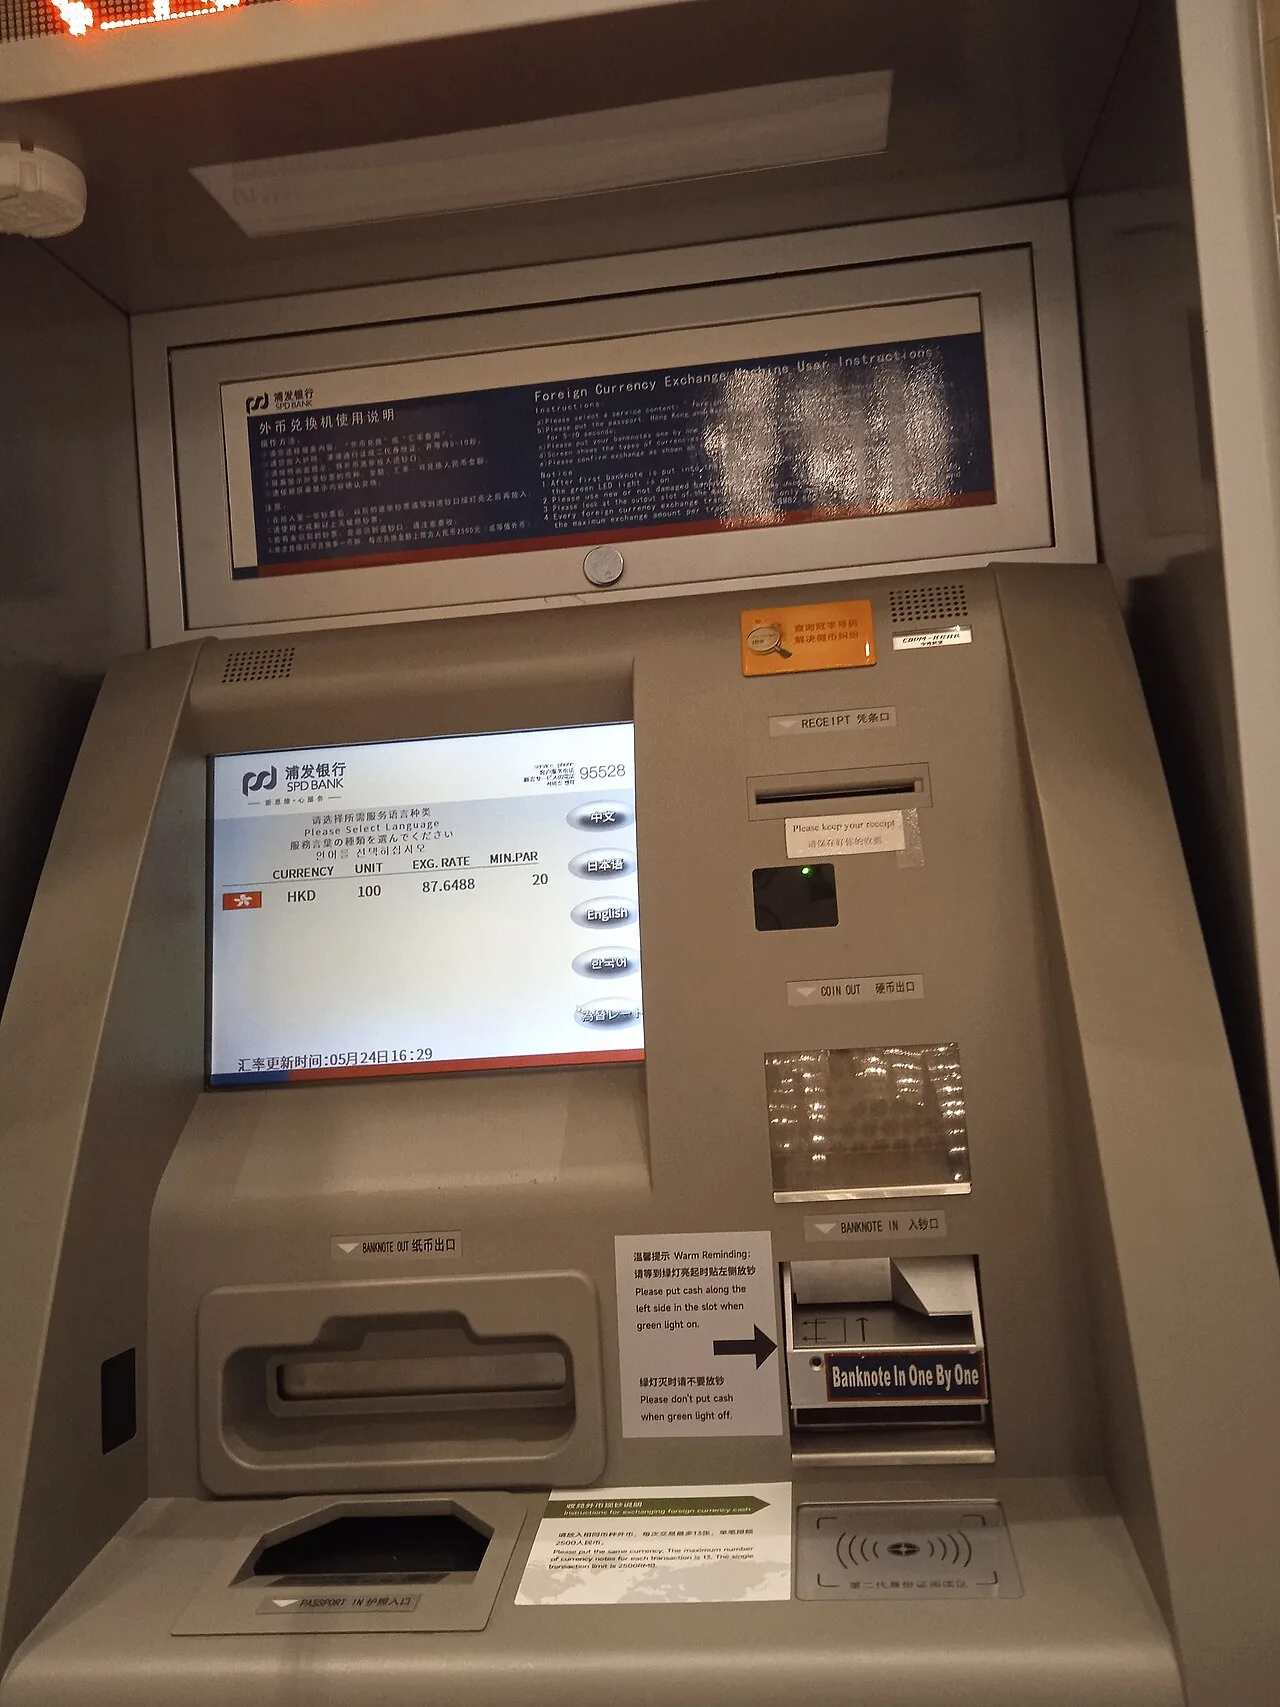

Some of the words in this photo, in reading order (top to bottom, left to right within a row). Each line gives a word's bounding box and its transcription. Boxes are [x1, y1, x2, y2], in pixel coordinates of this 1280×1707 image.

[535, 388, 588, 403] Foreign
[595, 380, 657, 395] Currency
[664, 371, 727, 387] Exchange
[797, 360, 828, 372] User
[839, 348, 933, 367] Instructions
[273, 388, 314, 402] 浦发银行
[275, 402, 292, 411] SPD
[291, 399, 313, 409] BANK
[259, 408, 395, 435] 外币兑换机使用说明
[550, 479, 573, 487] After
[579, 475, 601, 483] first
[605, 472, 643, 481] banknote
[661, 468, 675, 476] put
[570, 486, 594, 495] green
[598, 482, 613, 490] LED
[618, 480, 641, 489] light
[655, 483, 689, 493] damaged
[552, 504, 578, 512] Please
[582, 501, 598, 509] look
[631, 495, 656, 504] output
[553, 512, 577, 521] Every
[581, 508, 614, 517] foreign
[618, 504, 656, 514] currency
[660, 499, 699, 509] exchange
[554, 521, 568, 529] the
[572, 518, 606, 527] maximum
[610, 513, 648, 523] exchange
[653, 509, 682, 518] amount
[686, 508, 700, 516] per
[801, 715, 851, 729] RECEIPT
[856, 712, 890, 724] 凭条口
[285, 761, 346, 780] 浦发银行
[579, 763, 626, 780] 95528
[287, 780, 309, 792] SPD
[311, 777, 344, 790] BANK
[312, 808, 432, 825] 请选择所需服务语言种类
[589, 810, 616, 824] 中文
[304, 825, 341, 836] Please
[345, 824, 380, 834] Select
[385, 820, 440, 832] Language
[792, 823, 820, 833] Please
[821, 822, 843, 832] keep
[844, 821, 864, 832] your
[866, 819, 896, 829] receipt
[272, 866, 334, 880] CURRENCY
[354, 862, 384, 874] UNIT
[412, 859, 438, 870] EXG.
[441, 856, 470, 868] RATE
[489, 851, 539, 864] MIN.PAR
[287, 889, 316, 903] HKD
[357, 884, 381, 898] 100
[422, 878, 475, 893] 87.6488
[532, 873, 549, 886] 20
[586, 907, 629, 922] English
[591, 956, 628, 970] 한국어
[820, 985, 842, 997] COIN
[845, 984, 861, 995] OUT
[875, 981, 915, 994] 硬币出口
[840, 1220, 883, 1235] BANKNOTE
[888, 1219, 899, 1232] IN
[908, 1217, 939, 1231] 入钞口
[362, 1240, 394, 1254] BANKNOTE
[396, 1240, 409, 1253] OUT
[411, 1237, 456, 1253] 纸币出口
[633, 1251, 670, 1262] 温馨提示
[674, 1250, 700, 1261] Warm
[702, 1249, 751, 1260] Reminding:
[634, 1265, 756, 1279] 请等到绿灯亮起时贴左侧放钞
[635, 1287, 663, 1296] Please
[666, 1286, 681, 1297] put
[683, 1286, 703, 1295] cash
[705, 1285, 730, 1295] along
[732, 1284, 747, 1293] the
[636, 1304, 651, 1313] left
[653, 1303, 671, 1312] side
[673, 1303, 682, 1311] in
[684, 1302, 699, 1311] the
[701, 1301, 718, 1311] slot
[720, 1301, 745, 1311] when
[636, 1321, 662, 1332] green
[664, 1320, 684, 1331] light
[639, 1376, 725, 1388] 绿灯灭时请不要放钞
[832, 1365, 891, 1388] Banknote
[893, 1365, 906, 1386] In
[908, 1364, 934, 1386] One
[935, 1363, 952, 1391] By
[954, 1363, 980, 1385] One
[640, 1395, 669, 1404] Please
[671, 1393, 693, 1404] don't
[695, 1394, 711, 1405] put
[713, 1393, 734, 1403] cash
[641, 1412, 665, 1422] when
[667, 1412, 693, 1423] green
[695, 1411, 715, 1422] light
[717, 1410, 733, 1420] off.
[299, 1597, 346, 1607] PASSPORT
[350, 1596, 364, 1607] IN
[365, 1595, 411, 1607] 护照入口
